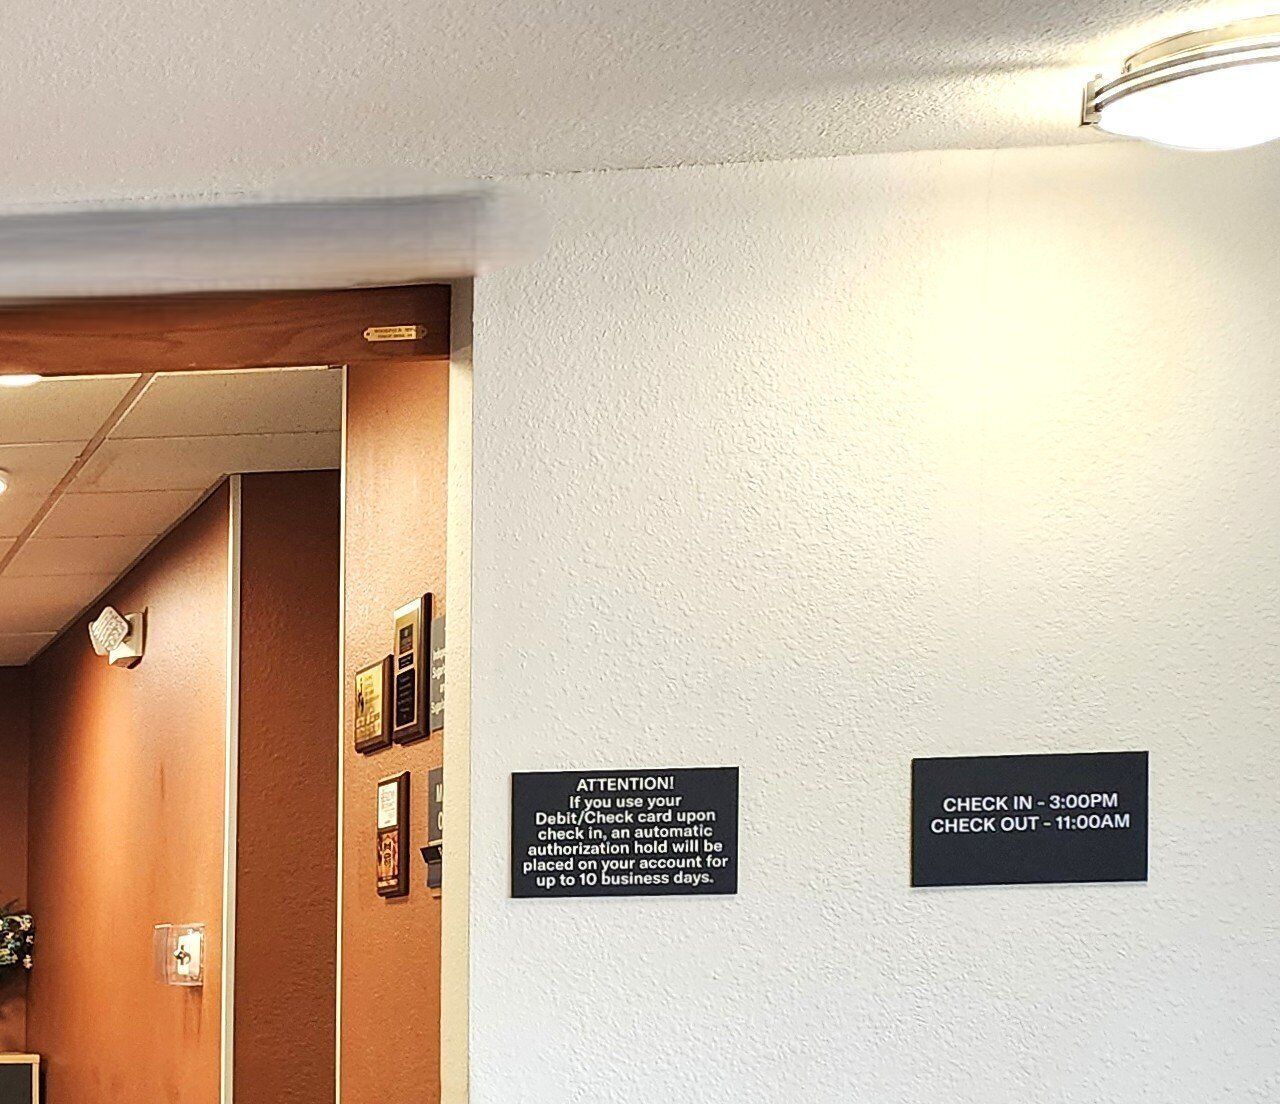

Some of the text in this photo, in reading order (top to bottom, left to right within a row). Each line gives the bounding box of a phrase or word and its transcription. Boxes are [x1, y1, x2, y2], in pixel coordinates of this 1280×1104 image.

[576, 776, 675, 792] ATTENTION!
[569, 795, 683, 812] If you use your
[943, 796, 1009, 812] CHECK
[1013, 795, 1033, 810] IN
[1049, 792, 1118, 809] 3:00PM
[535, 809, 716, 826] Debit/Check card upon
[930, 817, 996, 833] CHECK
[1000, 816, 1040, 832] OUT
[1055, 813, 1130, 830] 11:00AM
[537, 823, 714, 841] check in, an automatic
[527, 838, 723, 857] authorization hold will be
[523, 854, 729, 875] placed on your account for
[536, 870, 715, 890] up to 10 business days.
